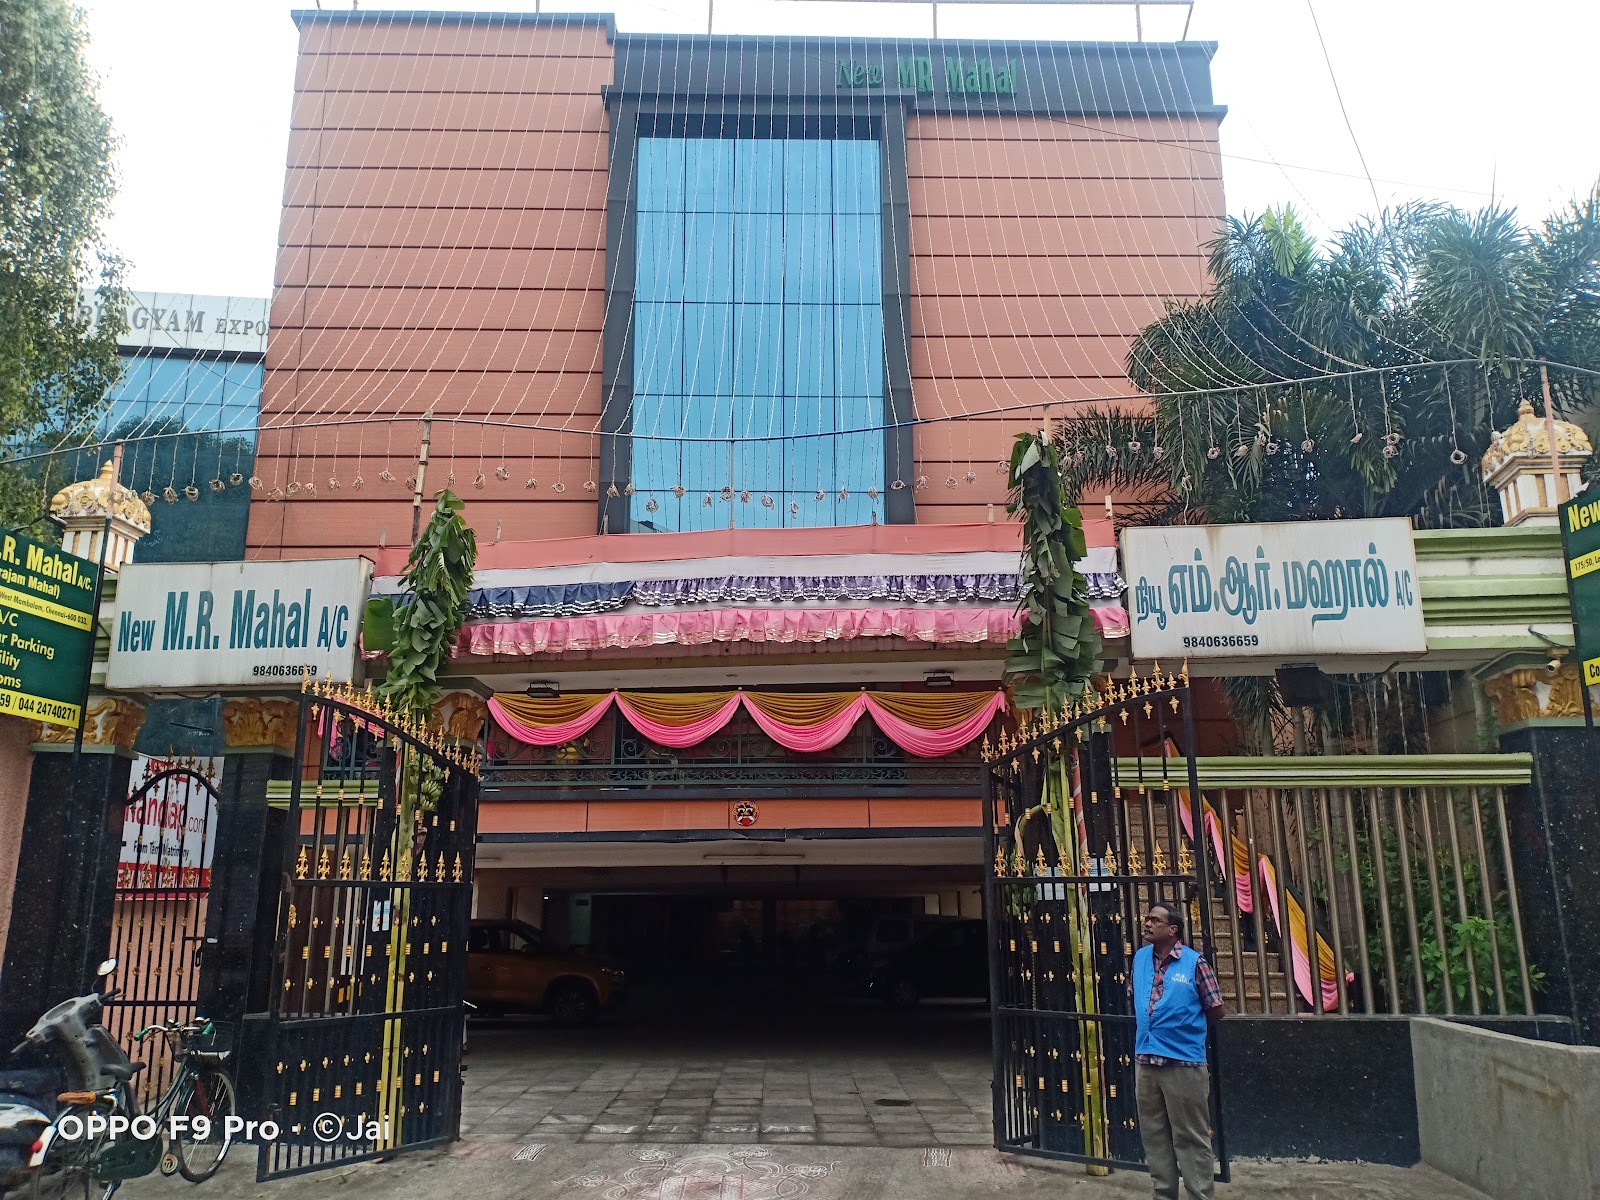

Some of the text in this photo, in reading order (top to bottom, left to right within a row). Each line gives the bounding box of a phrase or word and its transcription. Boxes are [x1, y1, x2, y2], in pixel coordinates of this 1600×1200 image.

[836, 55, 1017, 93] New MR Mahal
[79, 304, 268, 336] BGYAM EXPO
[26, 544, 79, 585] Mahal
[77, 575, 93, 591] A/C.
[28, 575, 60, 600] Mahal)
[1135, 576, 1166, 630] நியூ
[1395, 569, 1413, 610] A/C
[118, 589, 349, 652] New M.R. Mahal A/C
[11, 633, 55, 660] Parking
[1183, 634, 1259, 648] 9840636659
[19, 697, 34, 713] 044
[37, 701, 76, 721] 24740271
